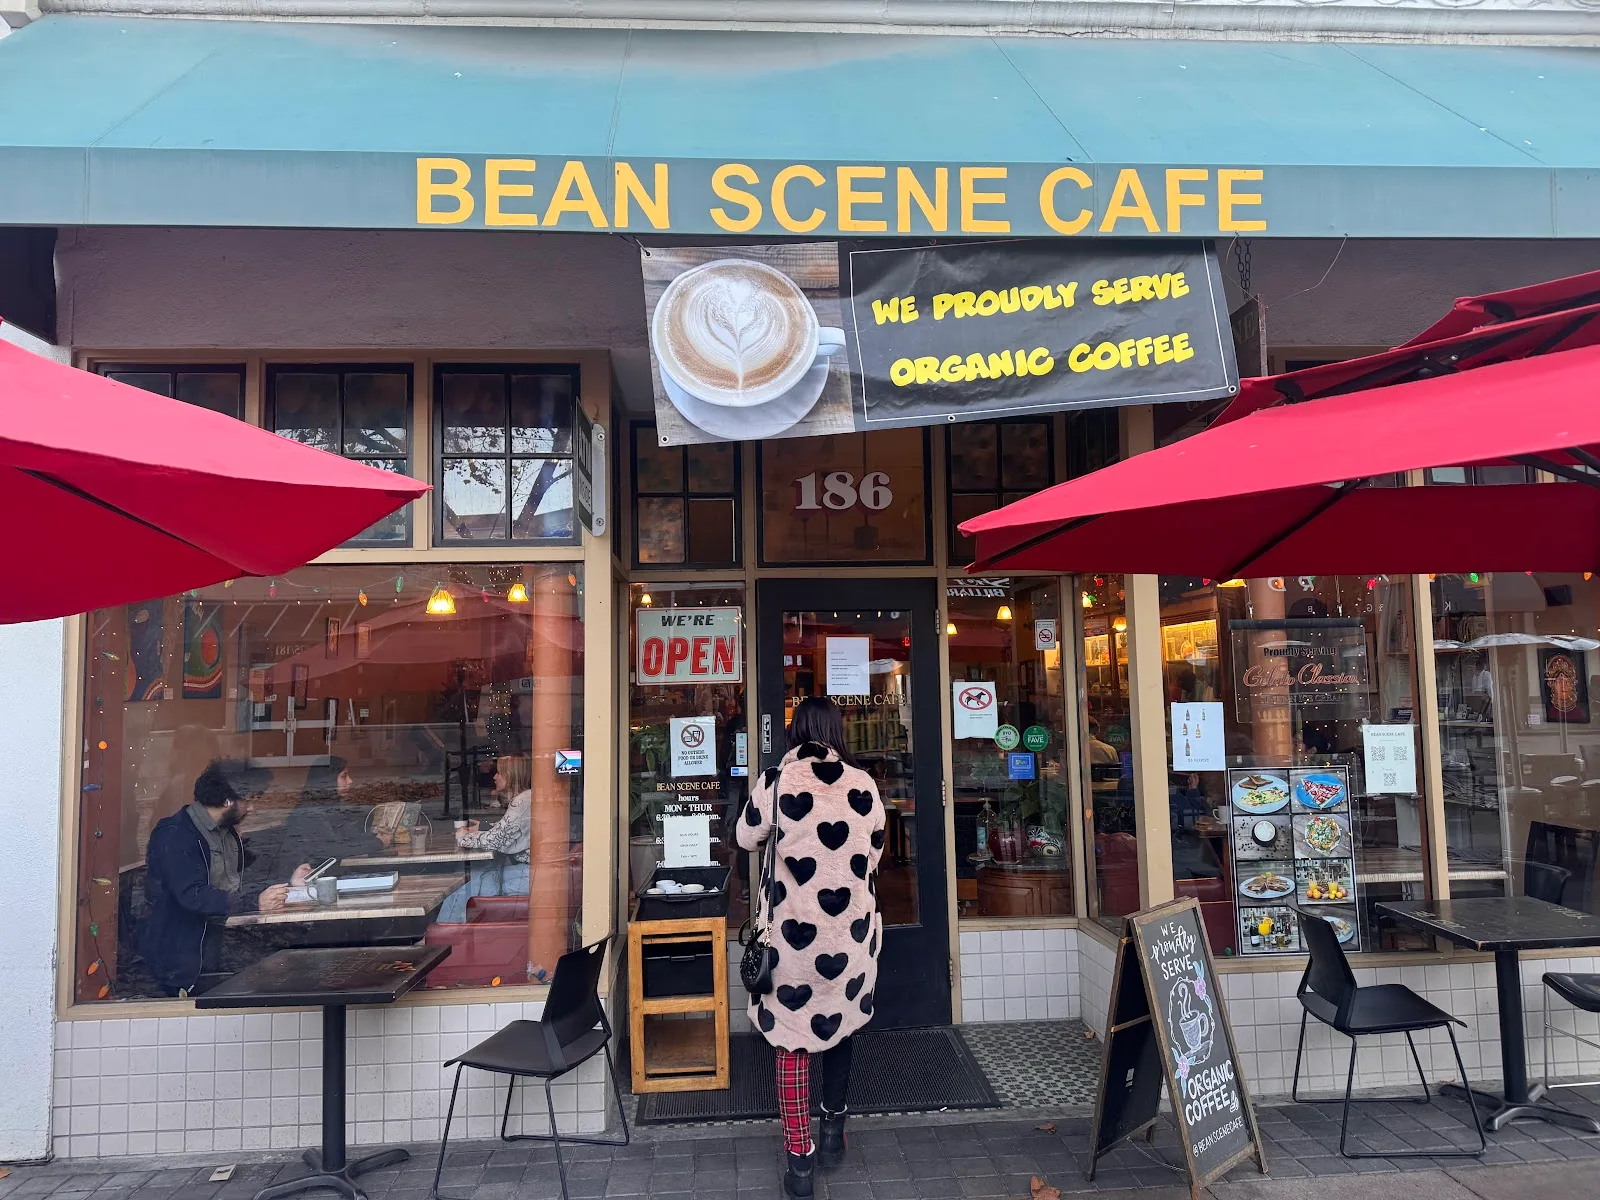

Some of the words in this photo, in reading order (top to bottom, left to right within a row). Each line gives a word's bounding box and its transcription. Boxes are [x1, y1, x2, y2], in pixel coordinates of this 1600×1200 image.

[416, 157, 670, 229] BEAN
[709, 163, 1011, 232] SCENE
[1039, 167, 1267, 235] CAFE
[871, 295, 920, 326] WE
[932, 281, 1079, 321] PROUDLY
[1091, 271, 1190, 307] SERVE
[889, 346, 1055, 387] ORGANIC
[1067, 332, 1195, 373] COFFEE
[795, 471, 893, 510] 186
[661, 614, 715, 627] WE'RE
[642, 635, 737, 678] OPEN
[1263, 647, 1300, 657] Proudly
[1243, 664, 1296, 687] Gelato
[1297, 662, 1359, 686] Classico
[830, 695, 872, 706] SCENE
[656, 782, 676, 791] BEAN
[676, 782, 700, 791] SCENE
[701, 781, 721, 790] CAFE
[677, 794, 700, 802] hours
[664, 804, 683, 812] MON
[688, 803, 713, 812] THUR
[1160, 921, 1177, 937] WE
[1150, 925, 1197, 965] proudly
[1161, 954, 1194, 980] SERVE
[1187, 1059, 1235, 1100] ORGANIC
[1185, 1083, 1231, 1126] COFFEE
